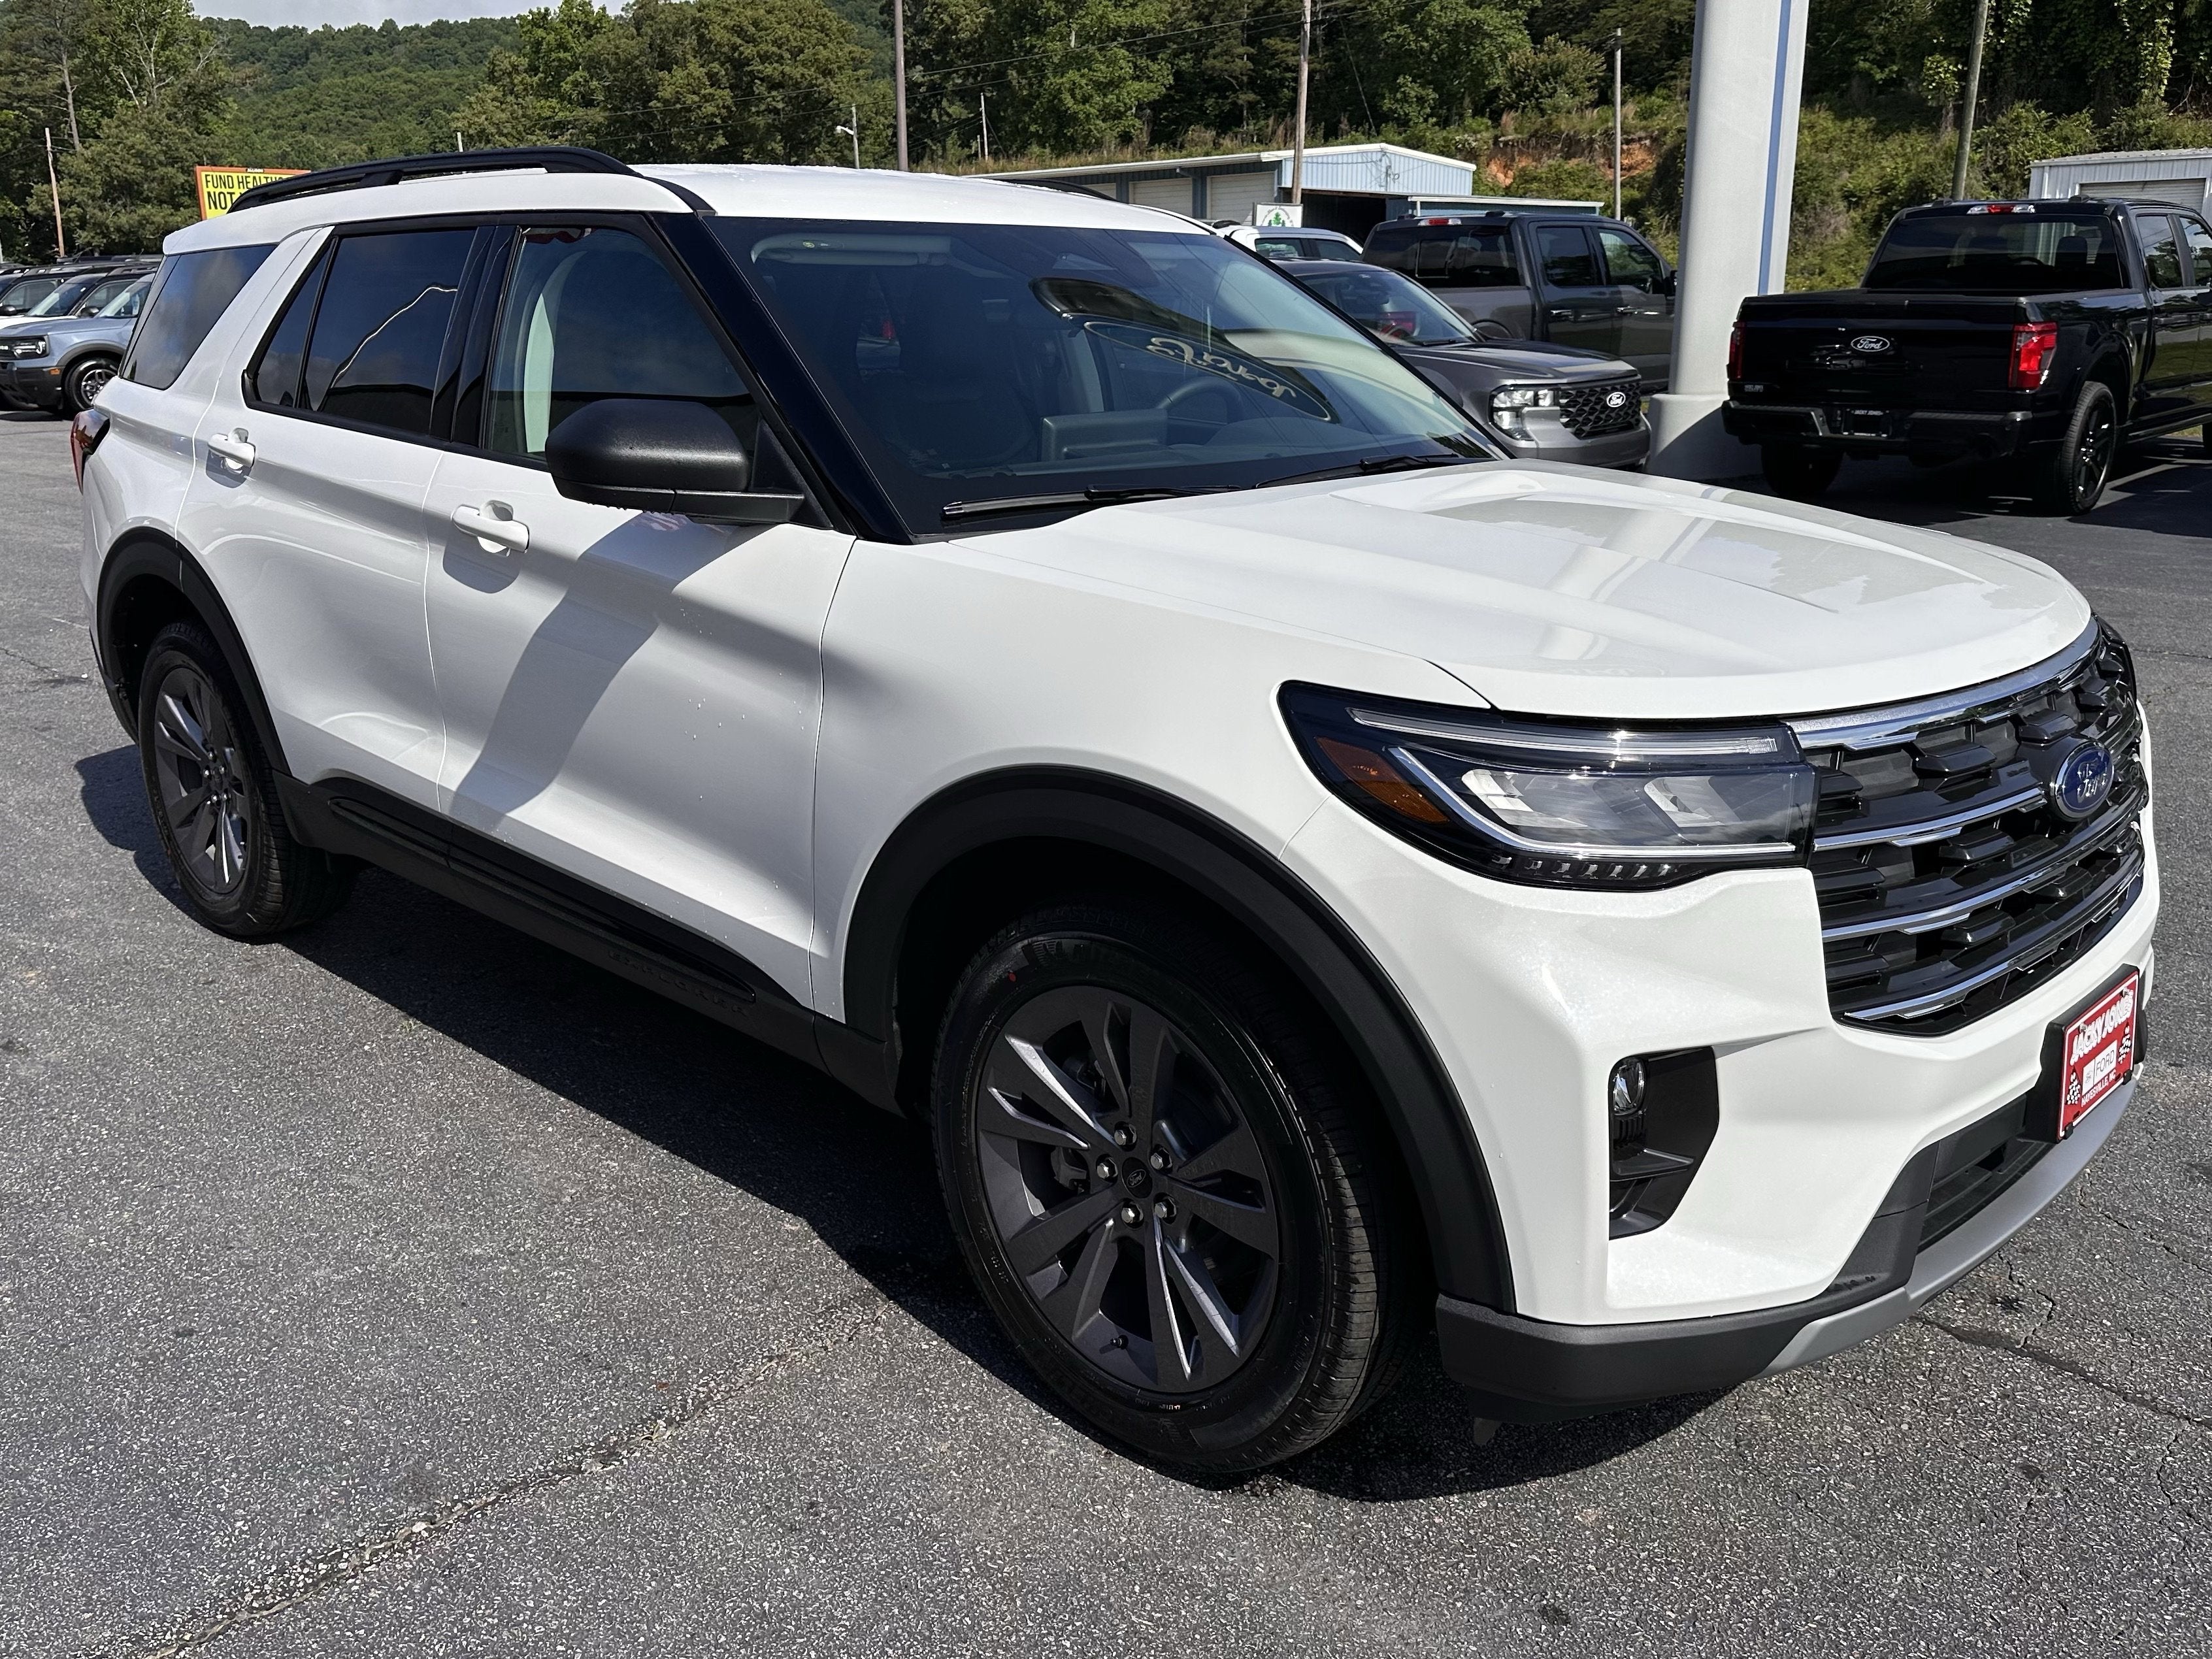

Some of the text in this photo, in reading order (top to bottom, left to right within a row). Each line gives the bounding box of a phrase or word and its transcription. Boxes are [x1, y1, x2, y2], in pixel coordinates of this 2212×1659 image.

[205, 174, 234, 189] FUND
[206, 191, 235, 210] NOT
[1857, 338, 1883, 350] Ford
[2096, 1049, 2115, 1077] FORD
[1129, 1172, 1142, 1186] Ford
